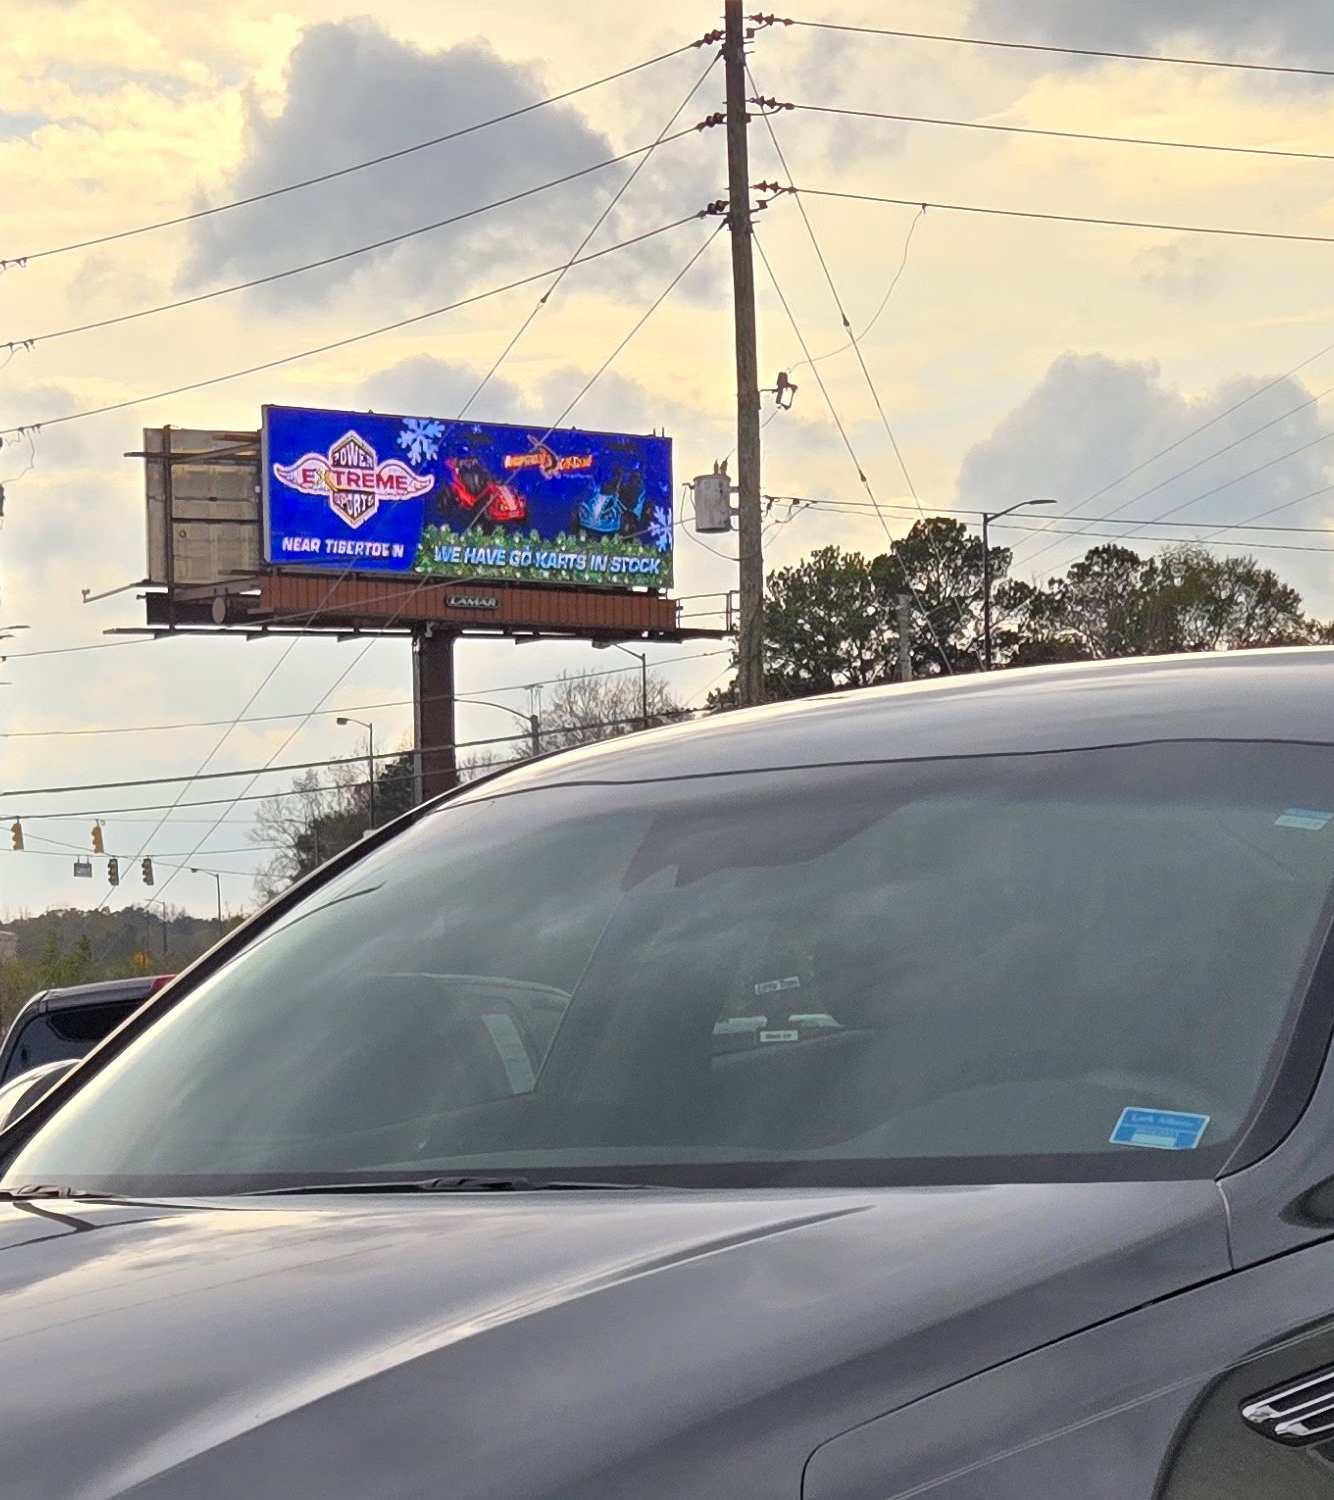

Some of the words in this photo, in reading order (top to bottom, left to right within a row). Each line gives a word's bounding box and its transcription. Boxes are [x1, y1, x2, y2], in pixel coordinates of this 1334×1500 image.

[333, 441, 373, 468] POWER
[302, 468, 409, 492] EXTREME
[282, 536, 321, 553] NEAR
[434, 546, 462, 563] WE
[463, 547, 506, 565] HAVE
[509, 548, 532, 567] GO
[535, 551, 586, 571] KARTS
[590, 554, 606, 571] IN
[610, 556, 661, 574] STOCK
[449, 597, 497, 607] LAMAR
